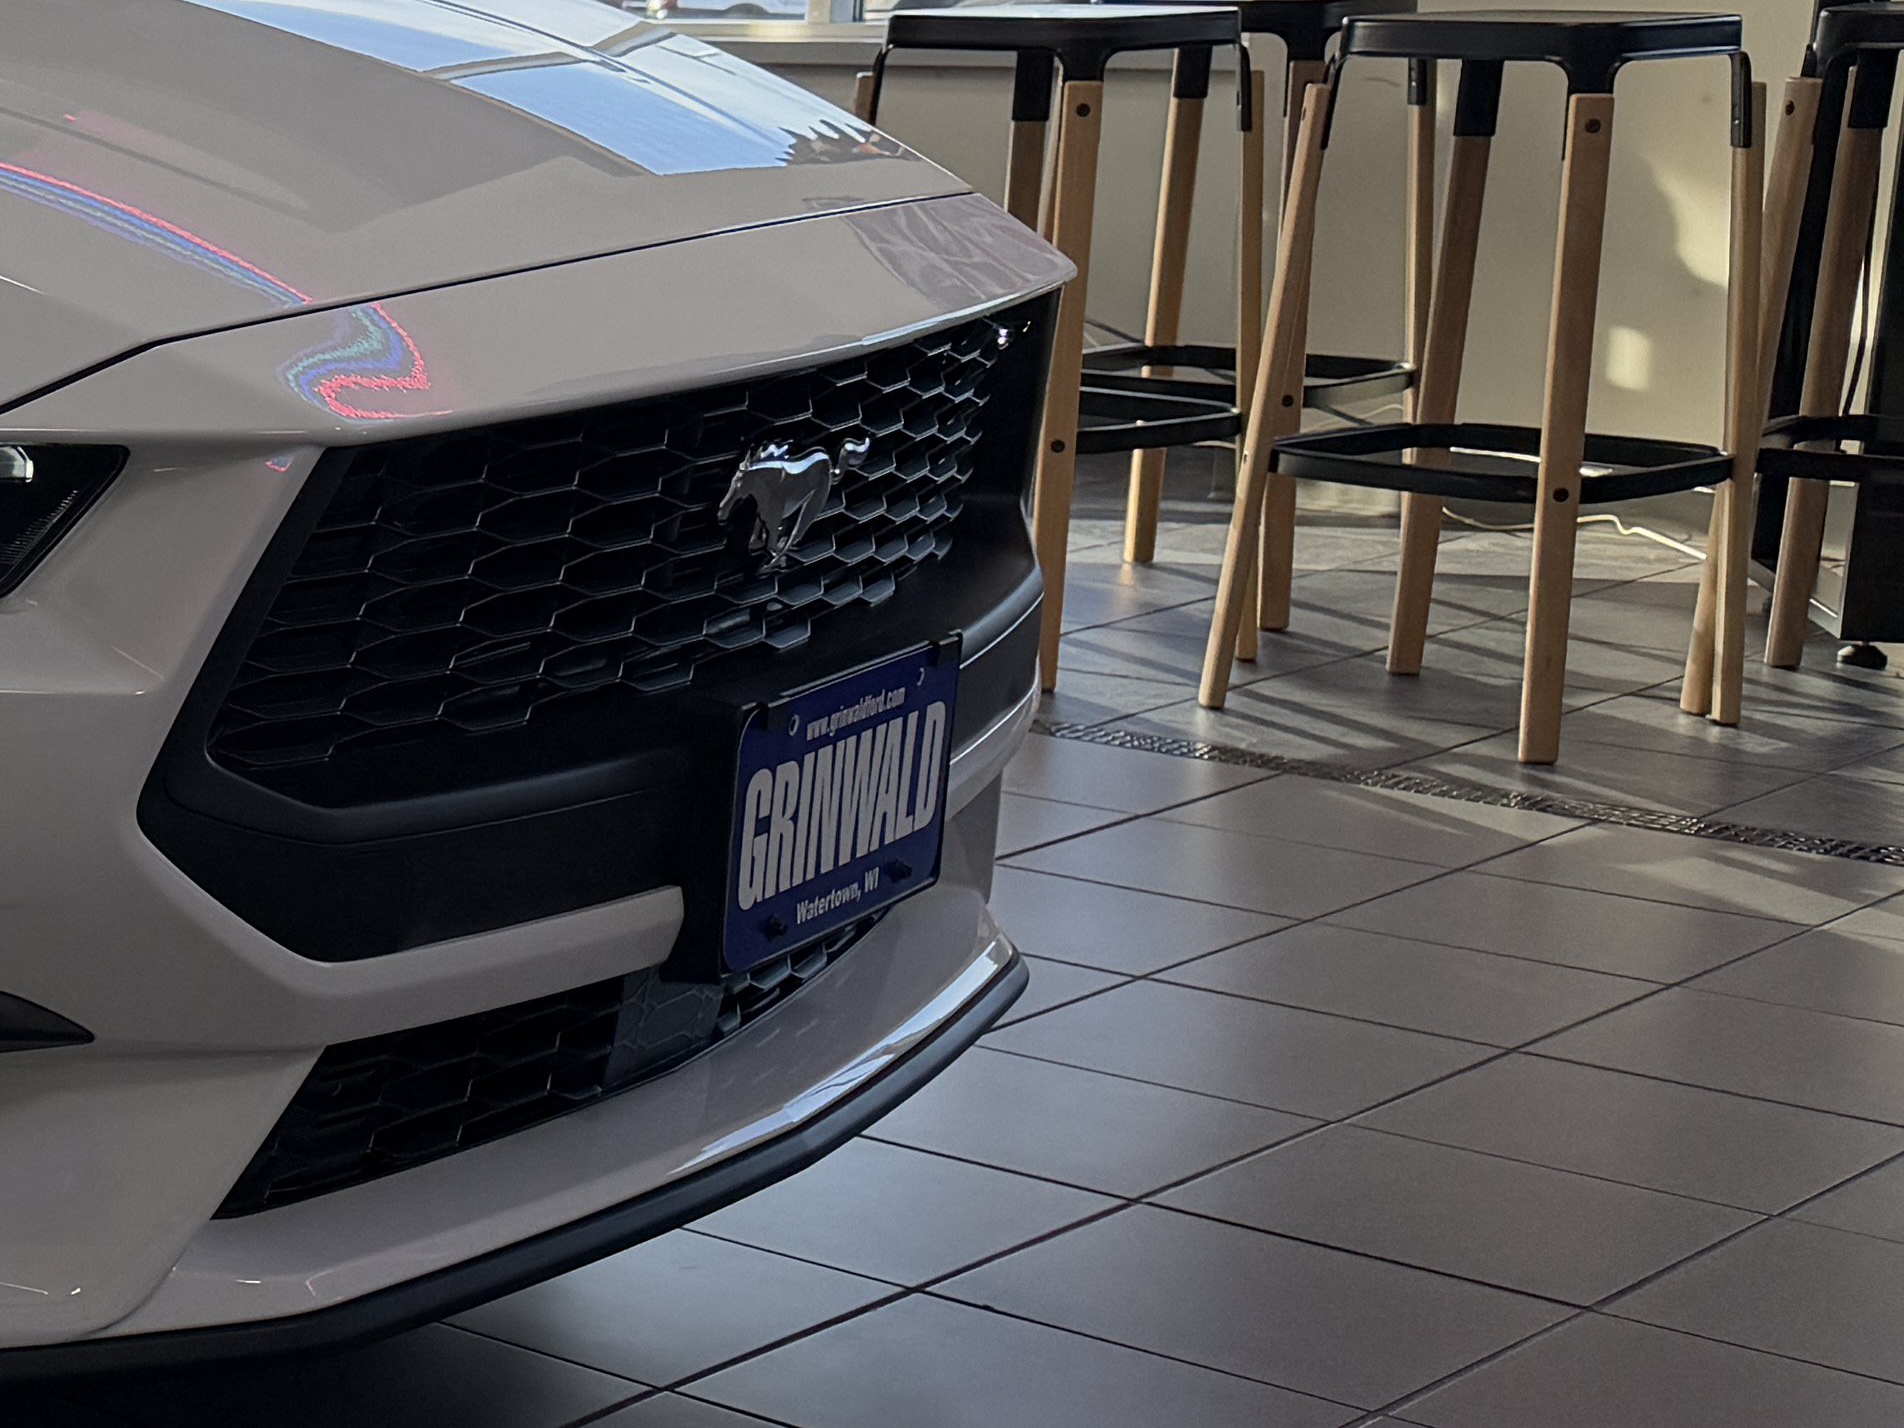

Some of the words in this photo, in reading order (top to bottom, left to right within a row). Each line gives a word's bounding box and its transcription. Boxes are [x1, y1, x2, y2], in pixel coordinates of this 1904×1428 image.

[806, 687, 906, 741] www.grinwaldford.com
[738, 701, 946, 910] GRINWALD
[797, 881, 862, 924] Watertown,
[865, 867, 880, 893] WI
